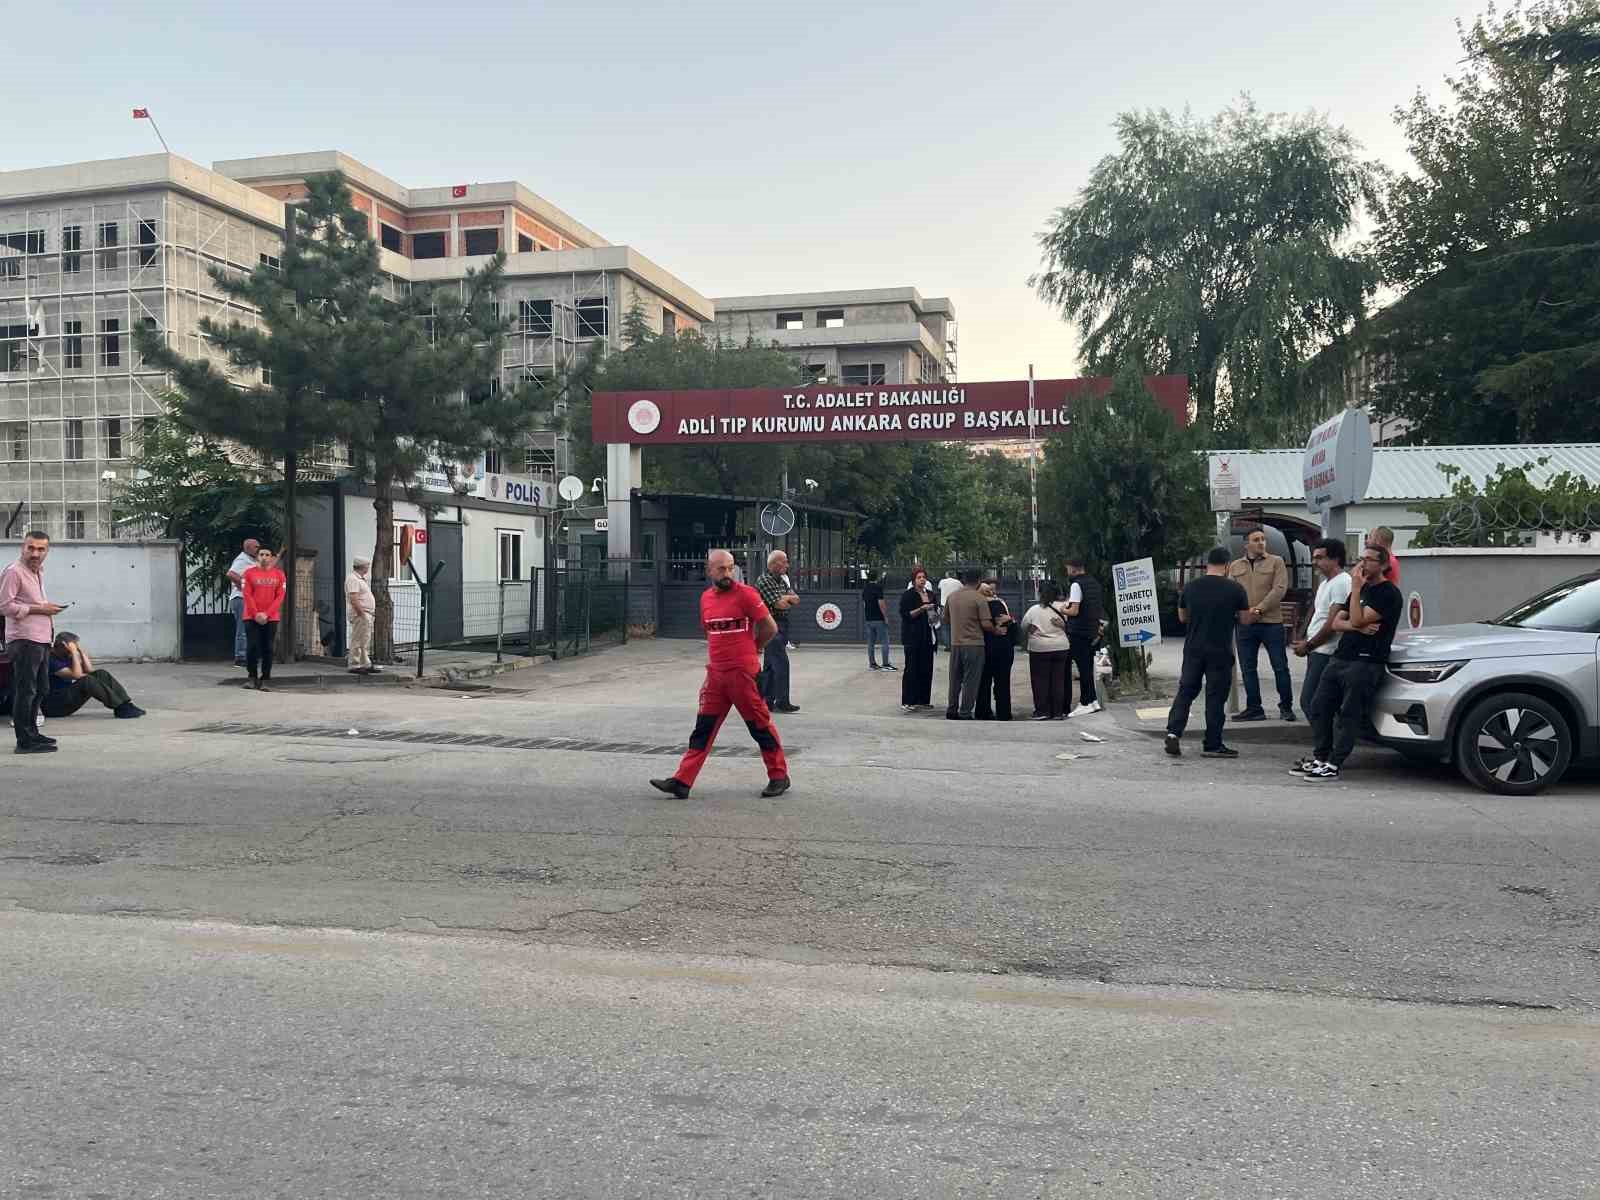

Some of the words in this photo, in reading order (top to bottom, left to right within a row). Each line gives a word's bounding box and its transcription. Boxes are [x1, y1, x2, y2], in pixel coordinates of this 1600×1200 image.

[783, 394, 811, 409] T.C.
[815, 391, 874, 408] ADALET
[878, 386, 965, 407] BAKANLIĞI
[678, 415, 715, 434] ADLİ
[720, 417, 748, 434] TIP
[751, 415, 825, 433] KURUMU
[830, 413, 902, 432] ANKARA
[907, 411, 957, 429] GRUP
[963, 404, 1078, 431] BAŞKANLIĞ
[506, 480, 541, 503] POLİS
